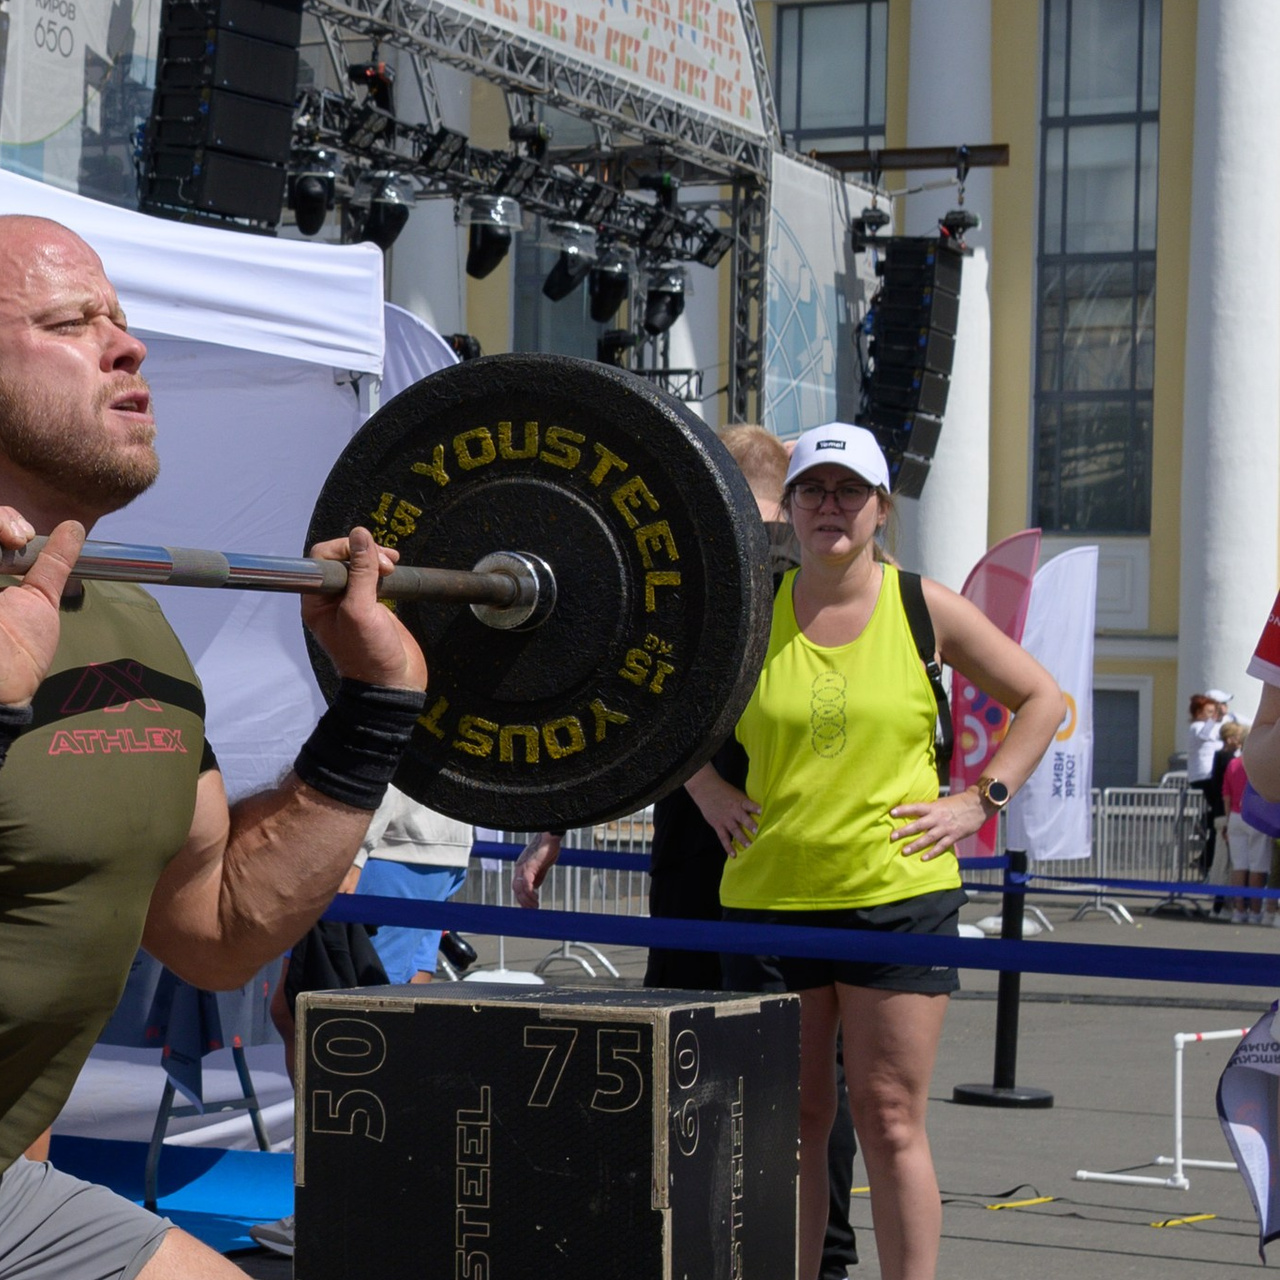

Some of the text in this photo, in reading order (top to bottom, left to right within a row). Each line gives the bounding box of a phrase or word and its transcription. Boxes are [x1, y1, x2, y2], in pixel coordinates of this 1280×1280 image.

[34, 16, 74, 58] 650
[411, 421, 681, 613] YOUSTEEL
[48, 727, 188, 755] ATHLEX
[312, 1018, 387, 1143] 50
[523, 1025, 644, 1112] 75
